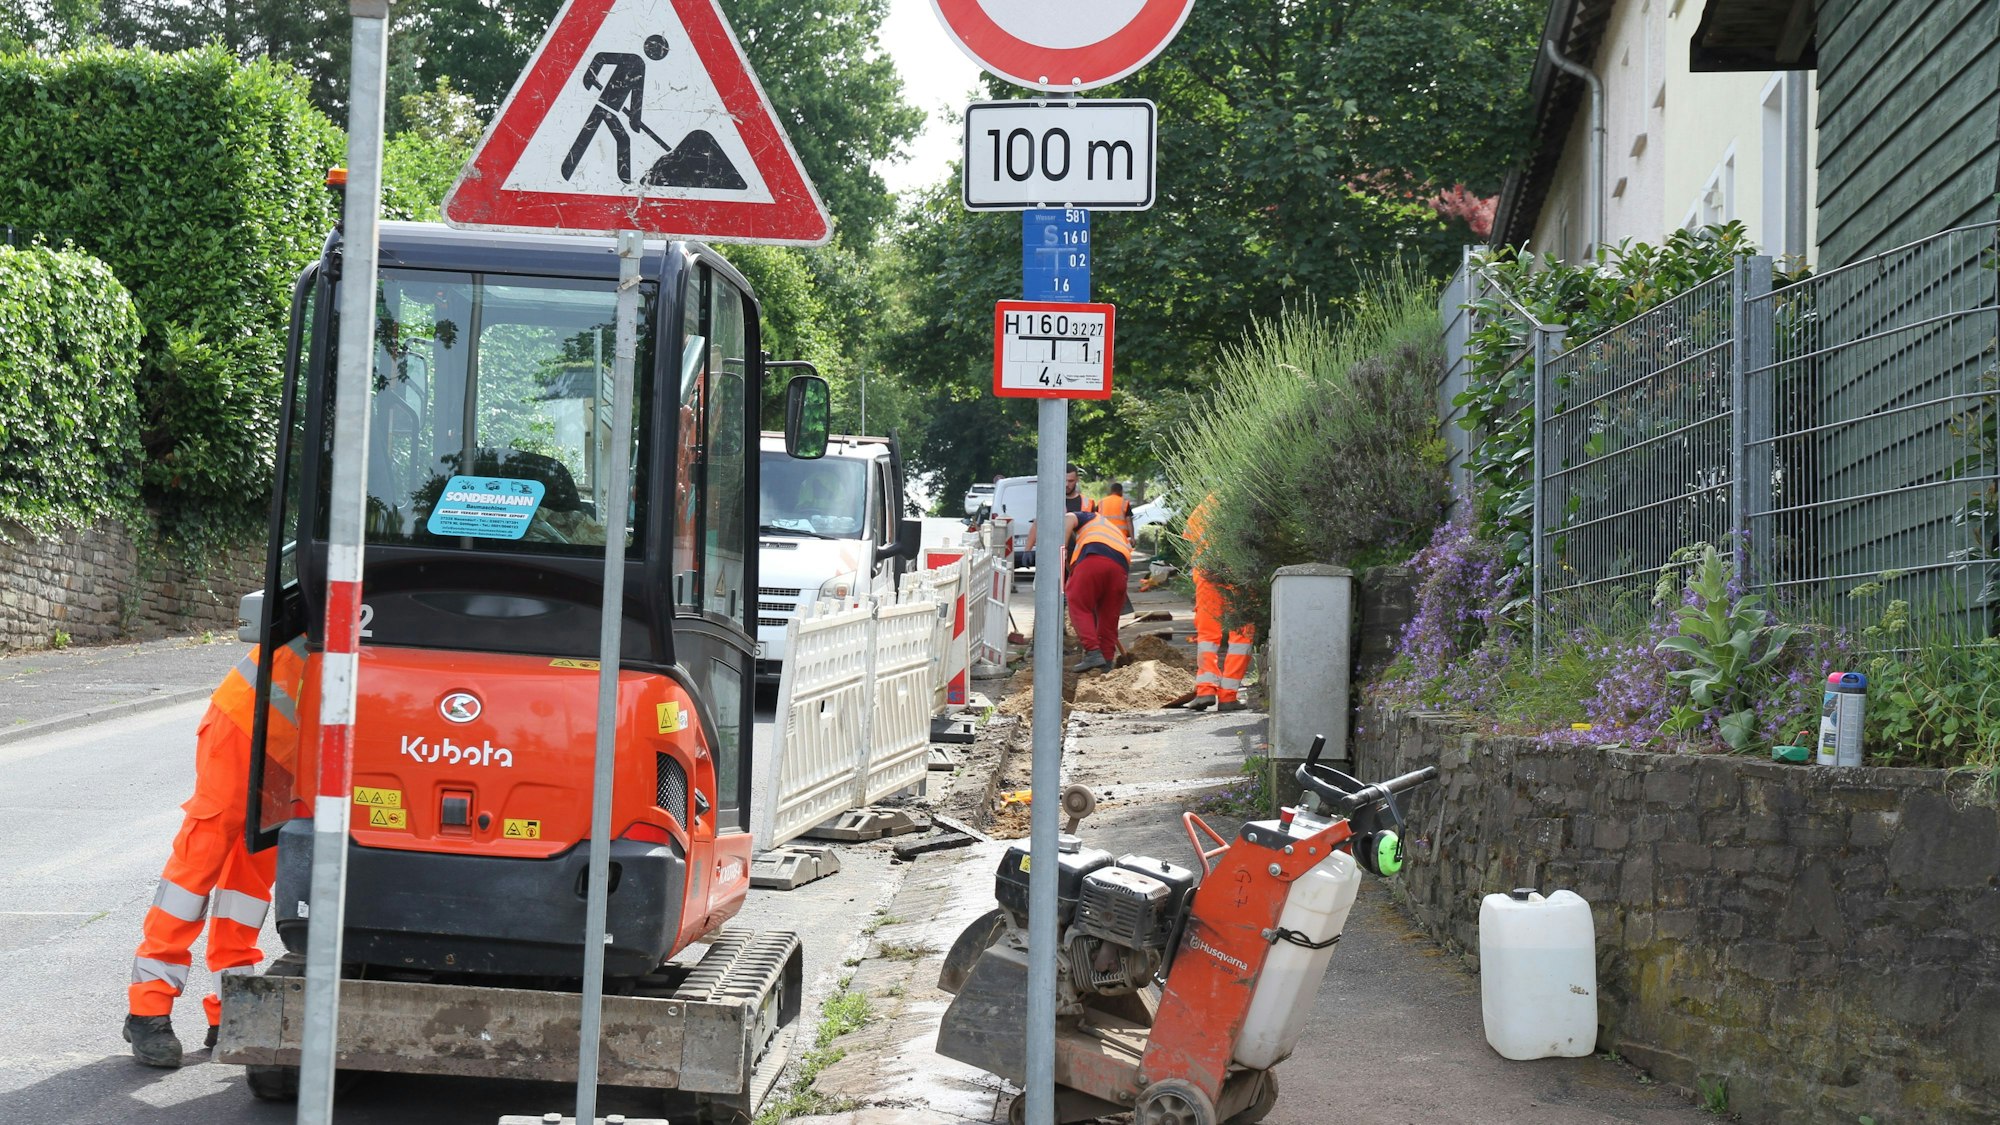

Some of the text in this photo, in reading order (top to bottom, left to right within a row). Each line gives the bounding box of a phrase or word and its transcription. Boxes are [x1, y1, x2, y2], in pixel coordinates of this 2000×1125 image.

[986, 127, 1133, 182] 100 m
[1065, 209, 1086, 224] 581
[1063, 229, 1088, 245] 160
[1005, 314, 1104, 337] H160 3227
[446, 491, 534, 506] SONDERMANN
[466, 503, 507, 512] Baumaschinen
[400, 735, 513, 768] Kubota
[1199, 940, 1248, 971] Husqvarna
